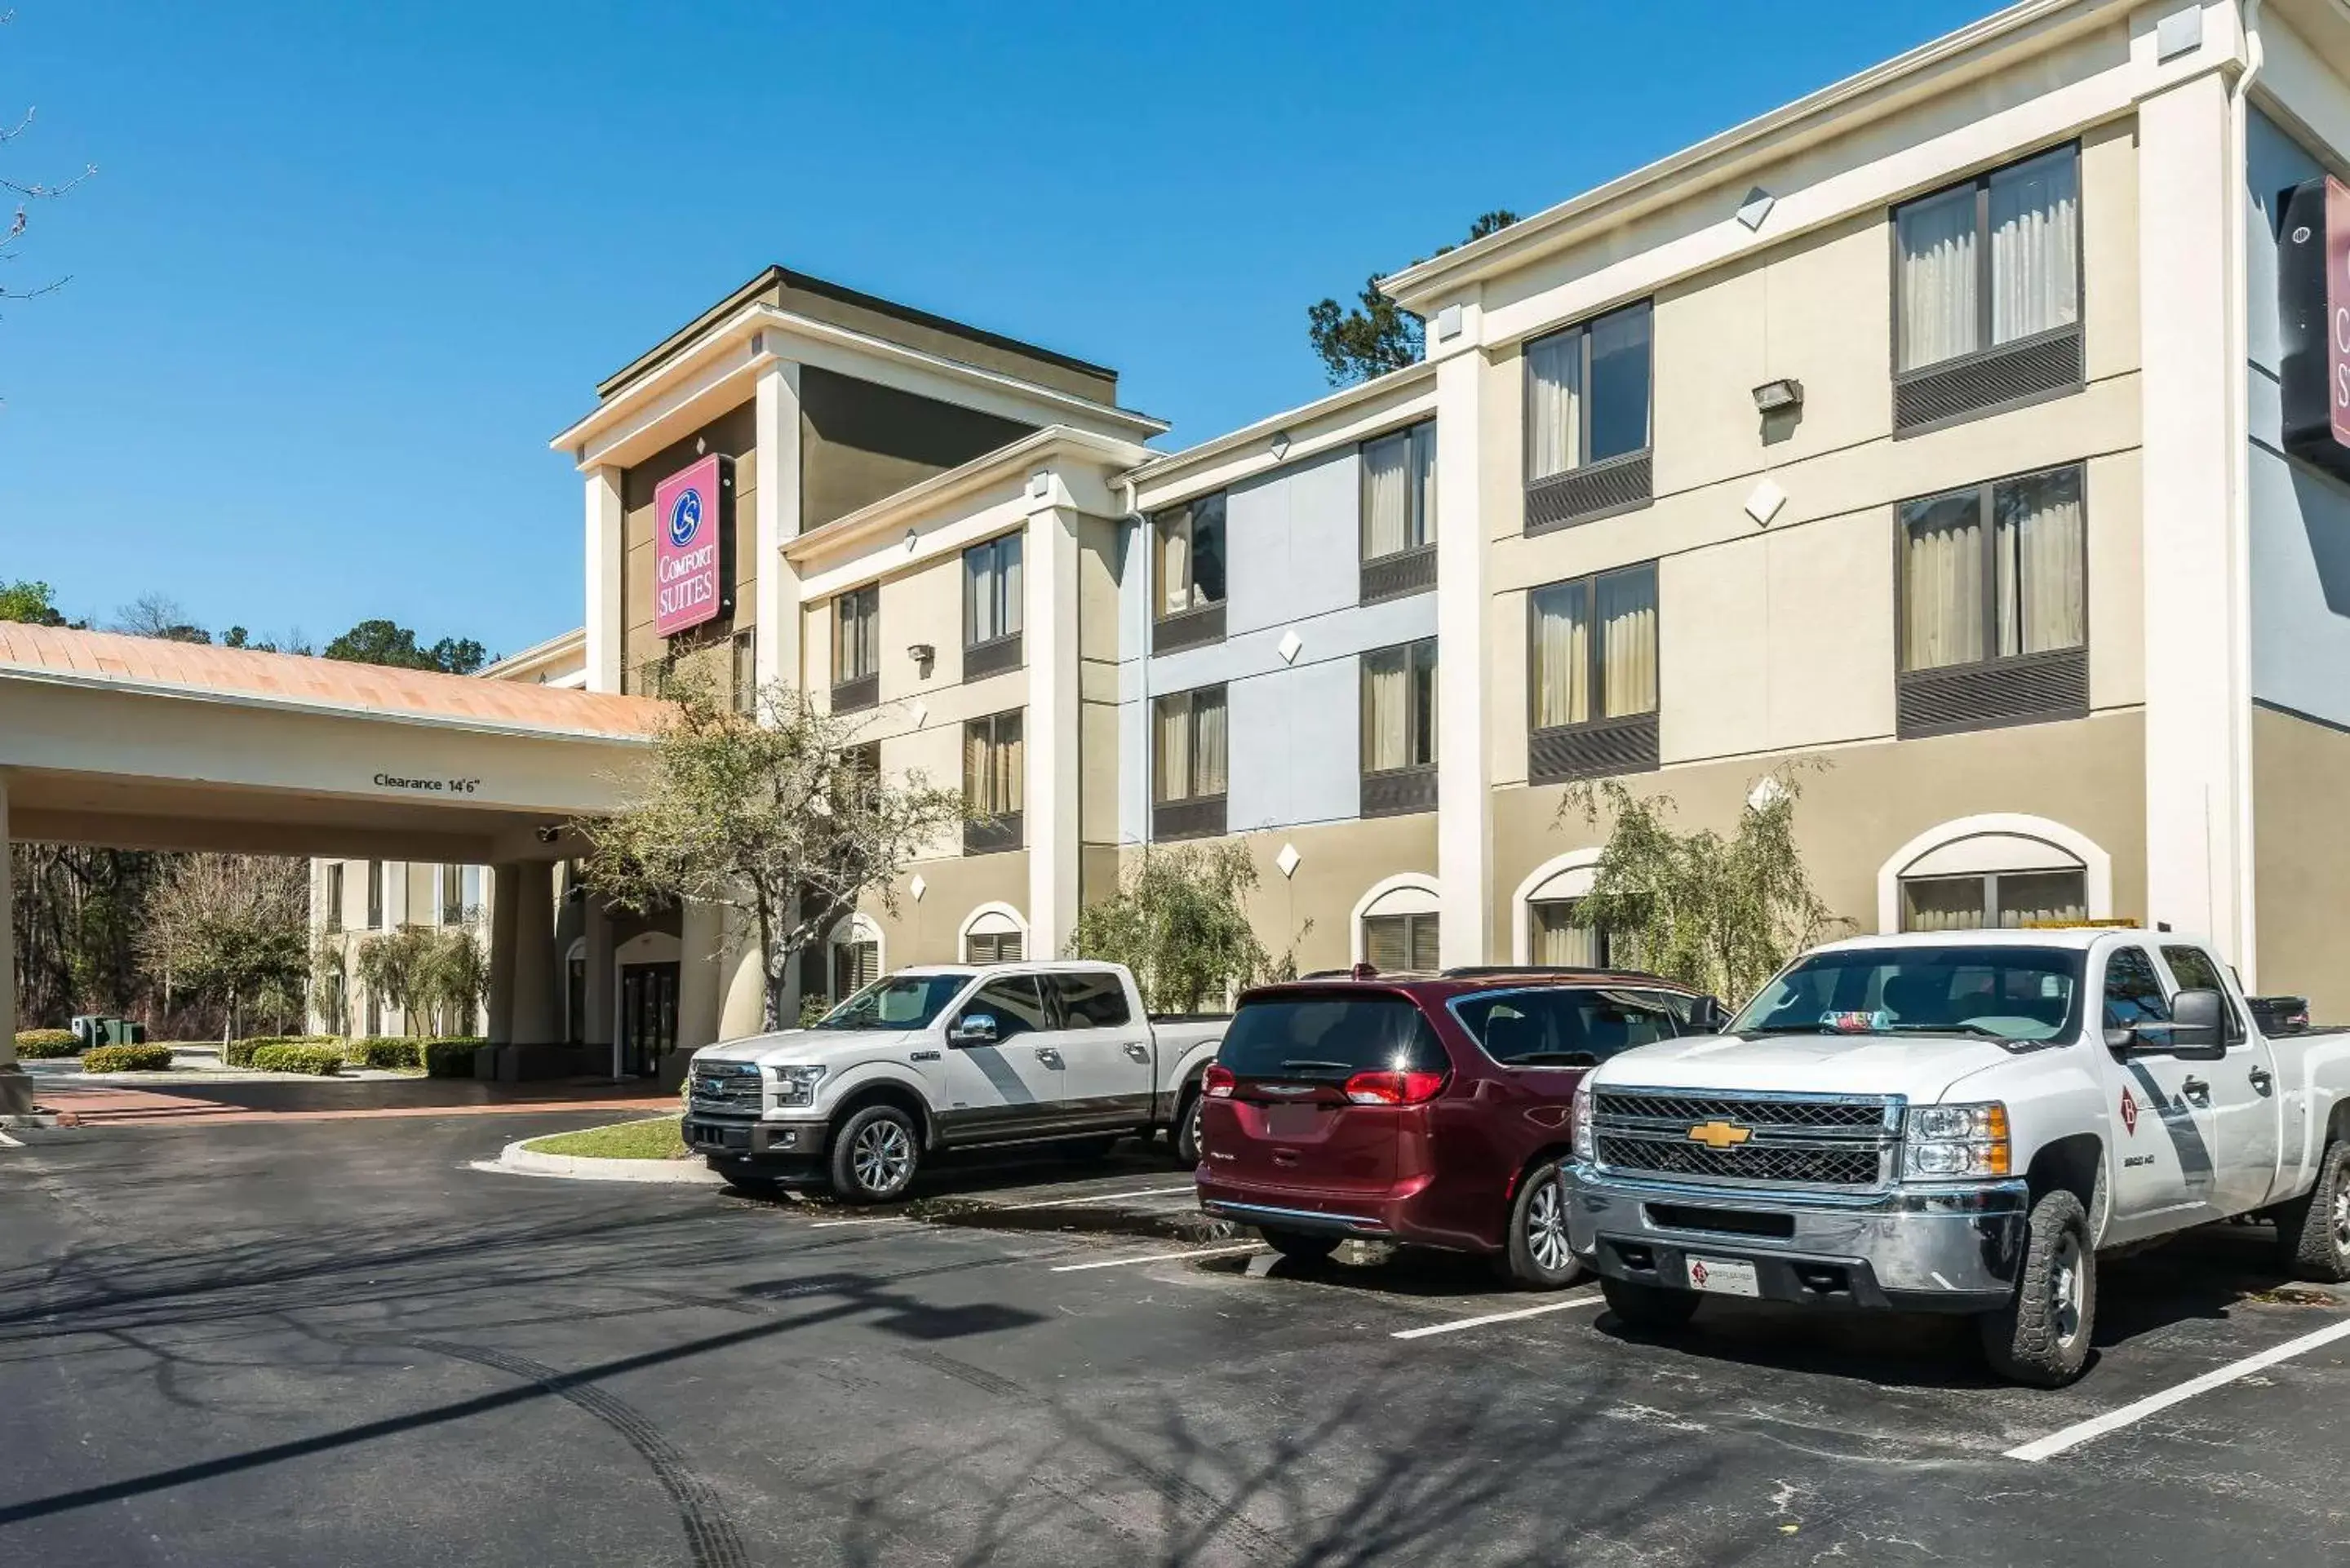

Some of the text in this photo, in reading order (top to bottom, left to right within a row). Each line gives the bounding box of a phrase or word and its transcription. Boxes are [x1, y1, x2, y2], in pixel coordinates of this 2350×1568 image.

[659, 546, 712, 584] COMFORT
[659, 571, 712, 618] SUITES
[374, 773, 442, 791] Clearance
[2122, 1099, 2135, 1125] B
